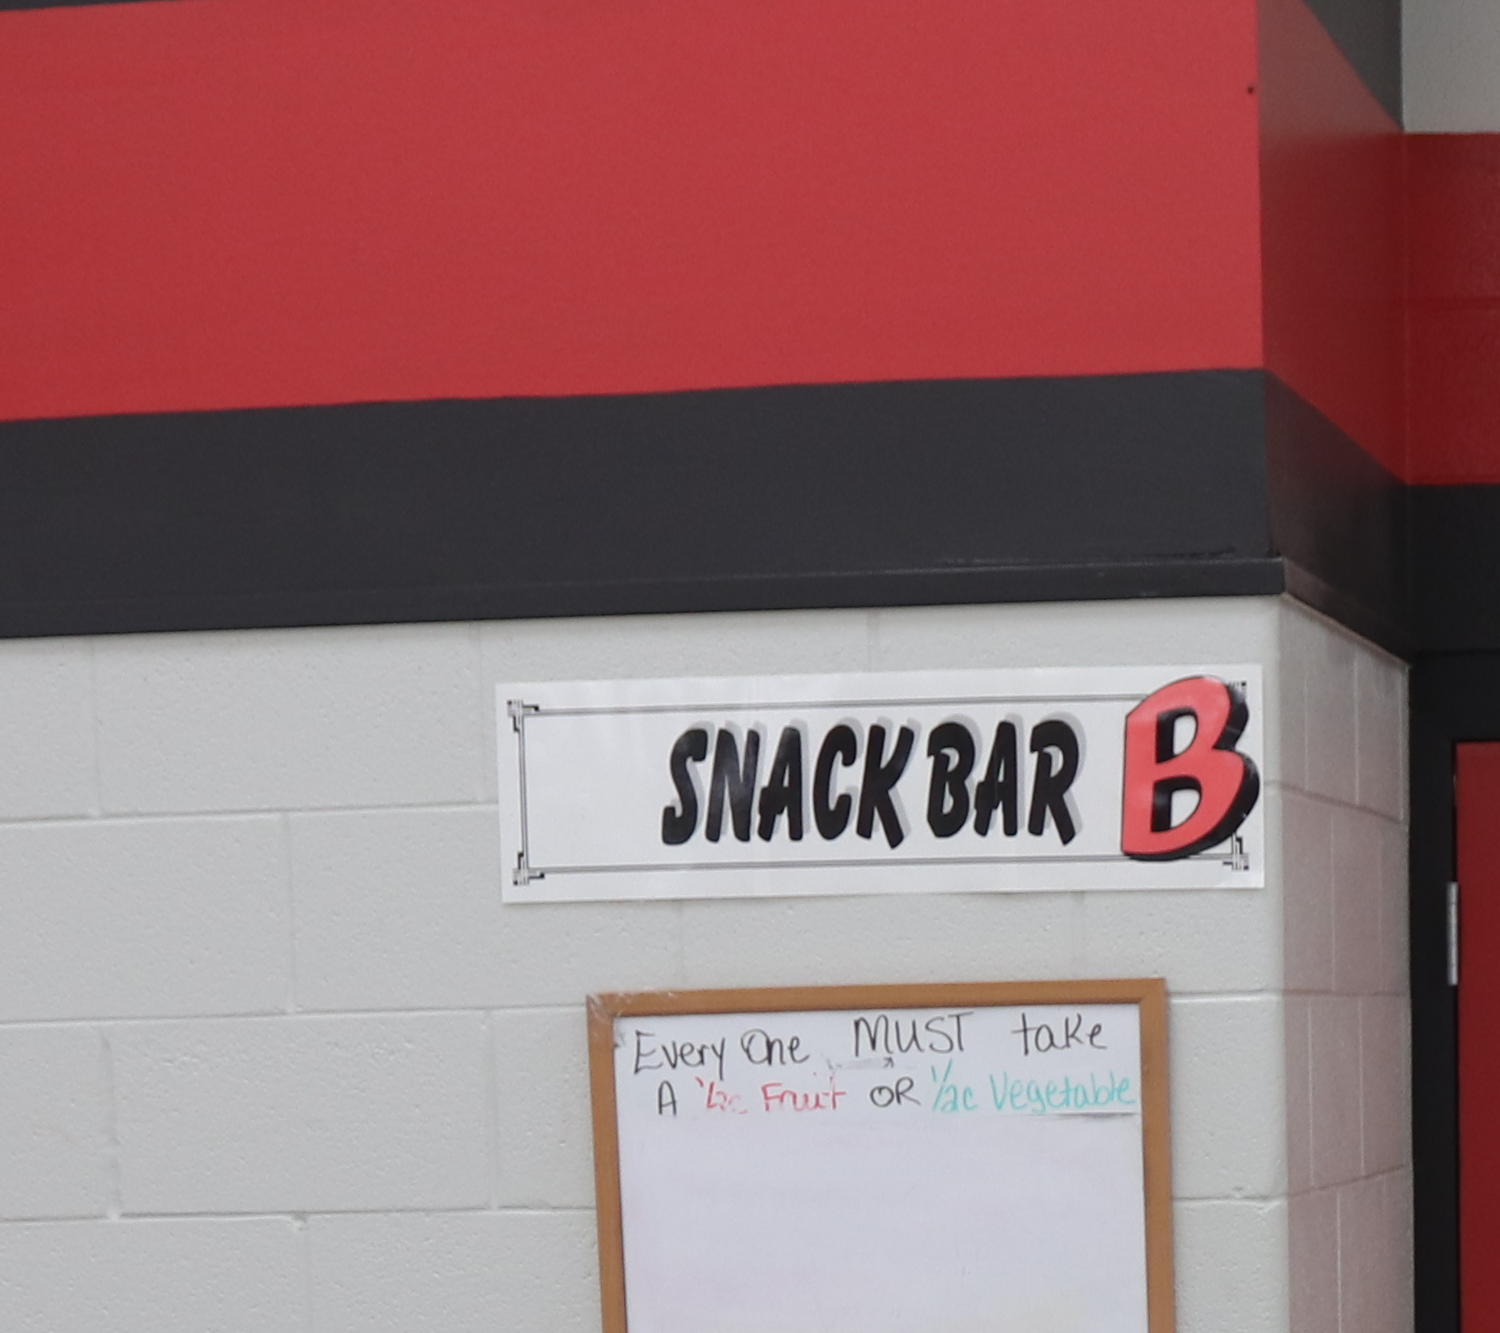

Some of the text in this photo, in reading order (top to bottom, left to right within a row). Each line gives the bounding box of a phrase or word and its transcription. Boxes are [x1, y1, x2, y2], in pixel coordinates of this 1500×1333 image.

[661, 674, 1260, 861] SNACK BAR B
[634, 1028, 727, 1082] Every
[741, 1028, 811, 1067] One
[853, 1010, 975, 1058] MUST
[657, 1079, 678, 1117] A
[869, 1076, 922, 1109] OR
[988, 1070, 1137, 1115] Vegetable
